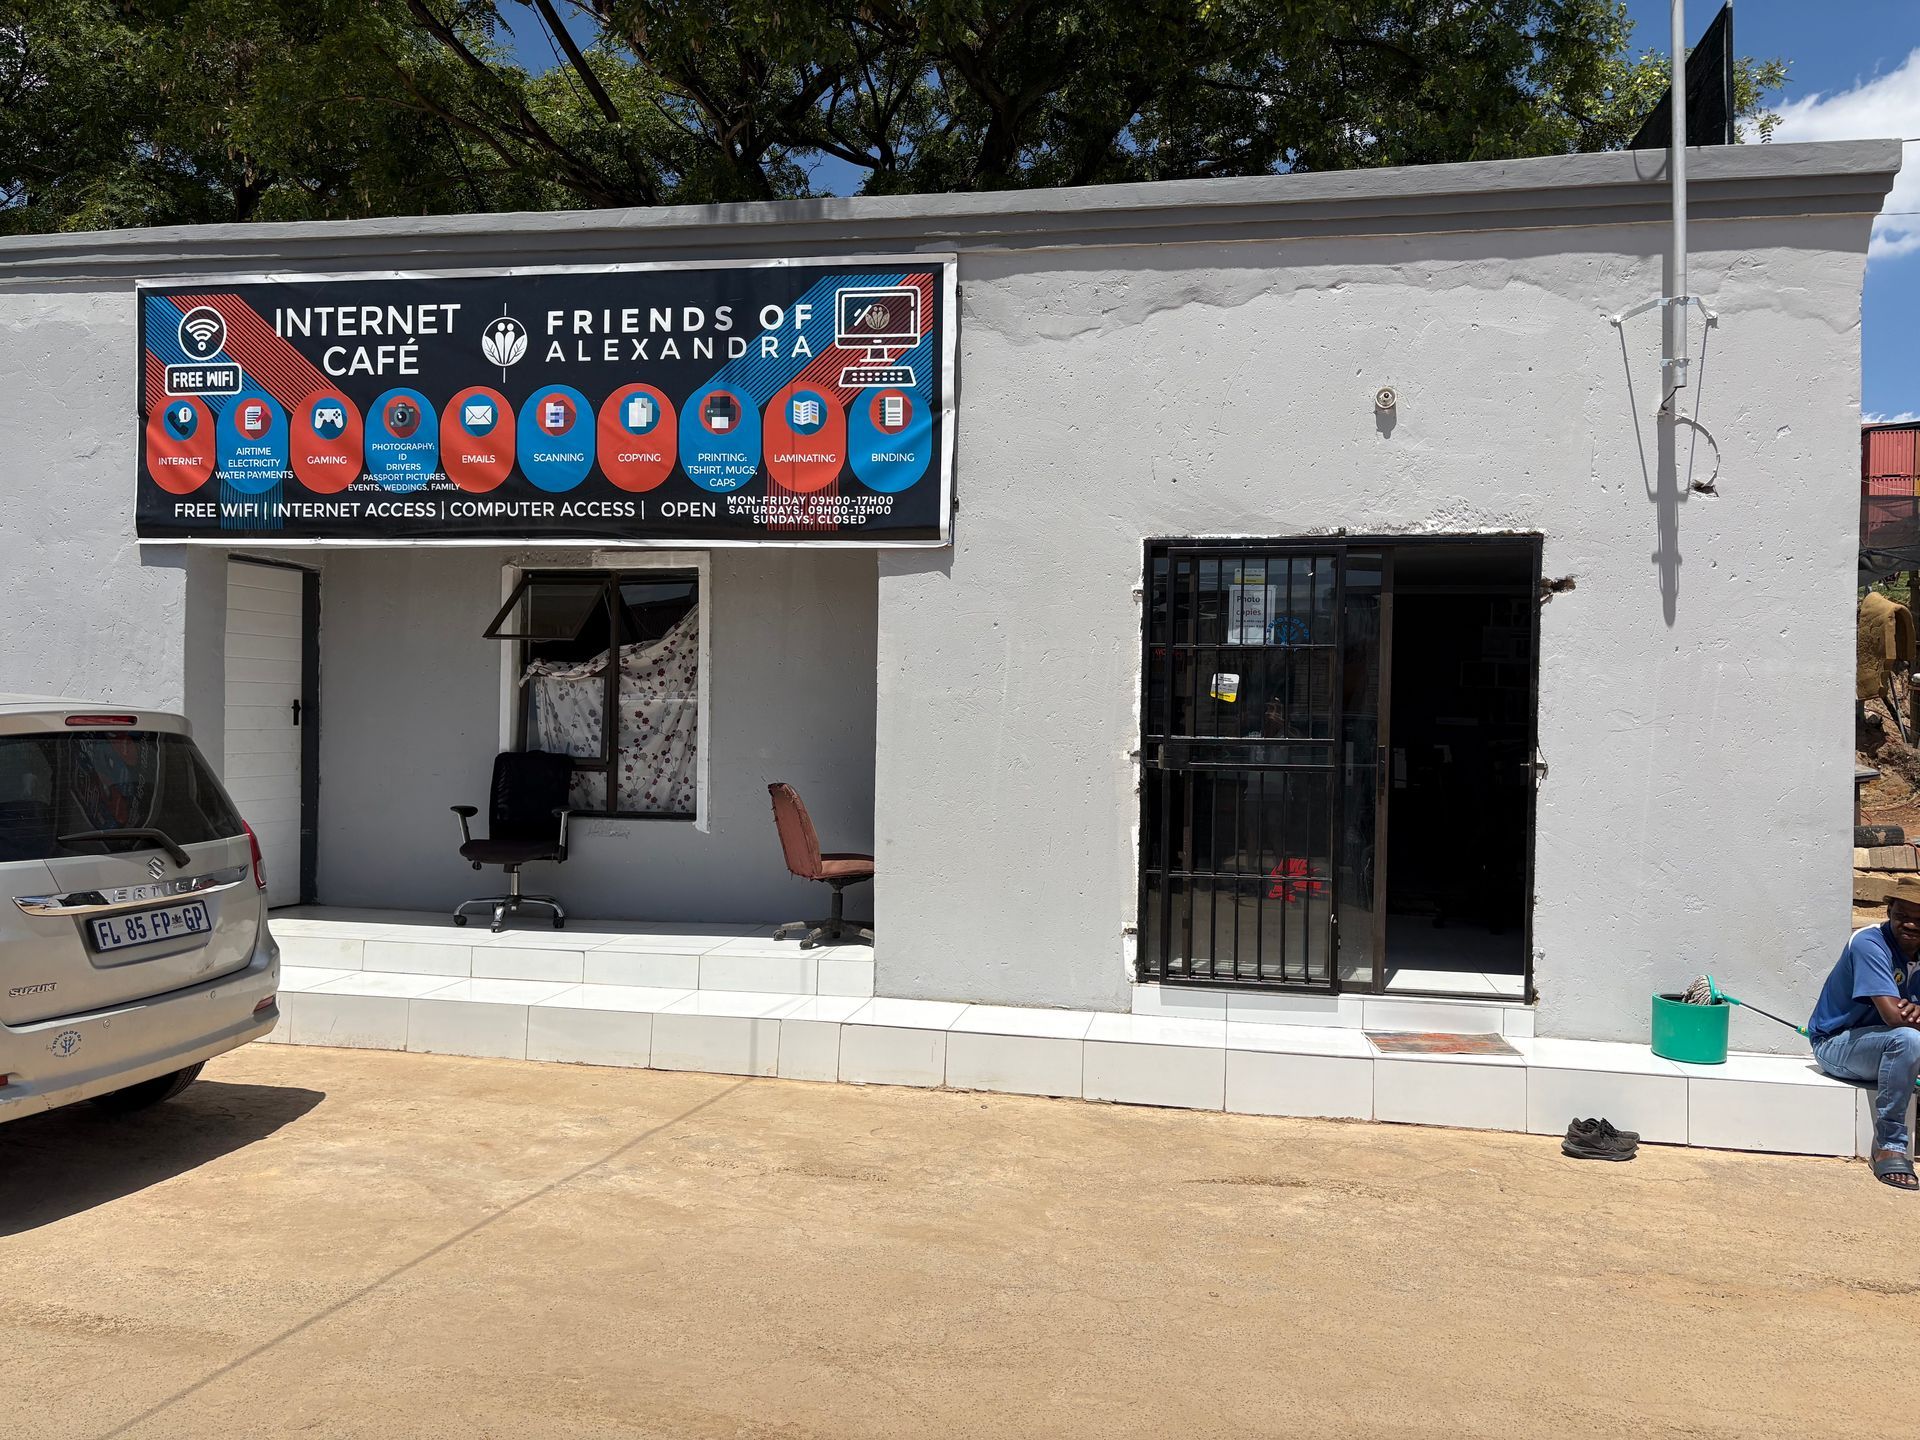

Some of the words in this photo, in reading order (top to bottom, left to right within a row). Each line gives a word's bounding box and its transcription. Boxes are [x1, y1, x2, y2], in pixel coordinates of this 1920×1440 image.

[275, 303, 461, 338] INTERNET
[546, 305, 734, 335] FRIENDS
[759, 303, 813, 331] OF
[545, 335, 813, 363] ALEXANDRA
[323, 338, 420, 377] CAFÉ
[172, 371, 204, 389] FREE
[207, 369, 234, 387] WIFI
[235, 446, 272, 456] AIRTIME
[372, 442, 435, 451] PHOTOGRAPHY:
[158, 456, 203, 466] INTERNET
[307, 455, 348, 465] GAMING
[398, 453, 407, 461] ID
[461, 454, 496, 464] EMAILS
[533, 453, 584, 463] SCANNING
[617, 453, 662, 463] COPYING
[698, 453, 748, 462] PRINTING:
[773, 453, 836, 463] LAMINATING
[871, 452, 915, 463] BINDING
[228, 458, 281, 468] ELECTRICITY
[386, 463, 421, 471] DRIVERS
[215, 470, 246, 480] WATER
[246, 470, 294, 479] PAYMENTS
[688, 465, 723, 475] TSHIRT,
[726, 465, 758, 476] MUGS,
[363, 473, 403, 482] PASSPORT
[405, 472, 446, 481] PICTURES
[347, 483, 382, 492] EVENTS,
[383, 483, 430, 492] WEDDINGS,
[431, 482, 461, 491] FAMILY
[709, 478, 736, 487] CAPS
[726, 495, 806, 505] MON-FRIDAY
[810, 495, 894, 505] 09H00-17H00
[174, 503, 217, 518] FREE
[220, 502, 258, 518] WIFI
[272, 502, 361, 518] INTERNET
[364, 502, 436, 518] ACCESS
[450, 501, 555, 518] COMPUTER
[560, 501, 635, 518] ACCESS
[660, 502, 717, 518] OPEN
[808, 505, 892, 515] 09H00-13H00
[817, 515, 867, 524] CLOSED
[112, 878, 202, 903] ERTIGA
[98, 921, 121, 947] FL
[125, 916, 147, 941] 85
[150, 911, 171, 936] FP
[182, 906, 203, 931] GP
[9, 982, 58, 998] SUZUKI
